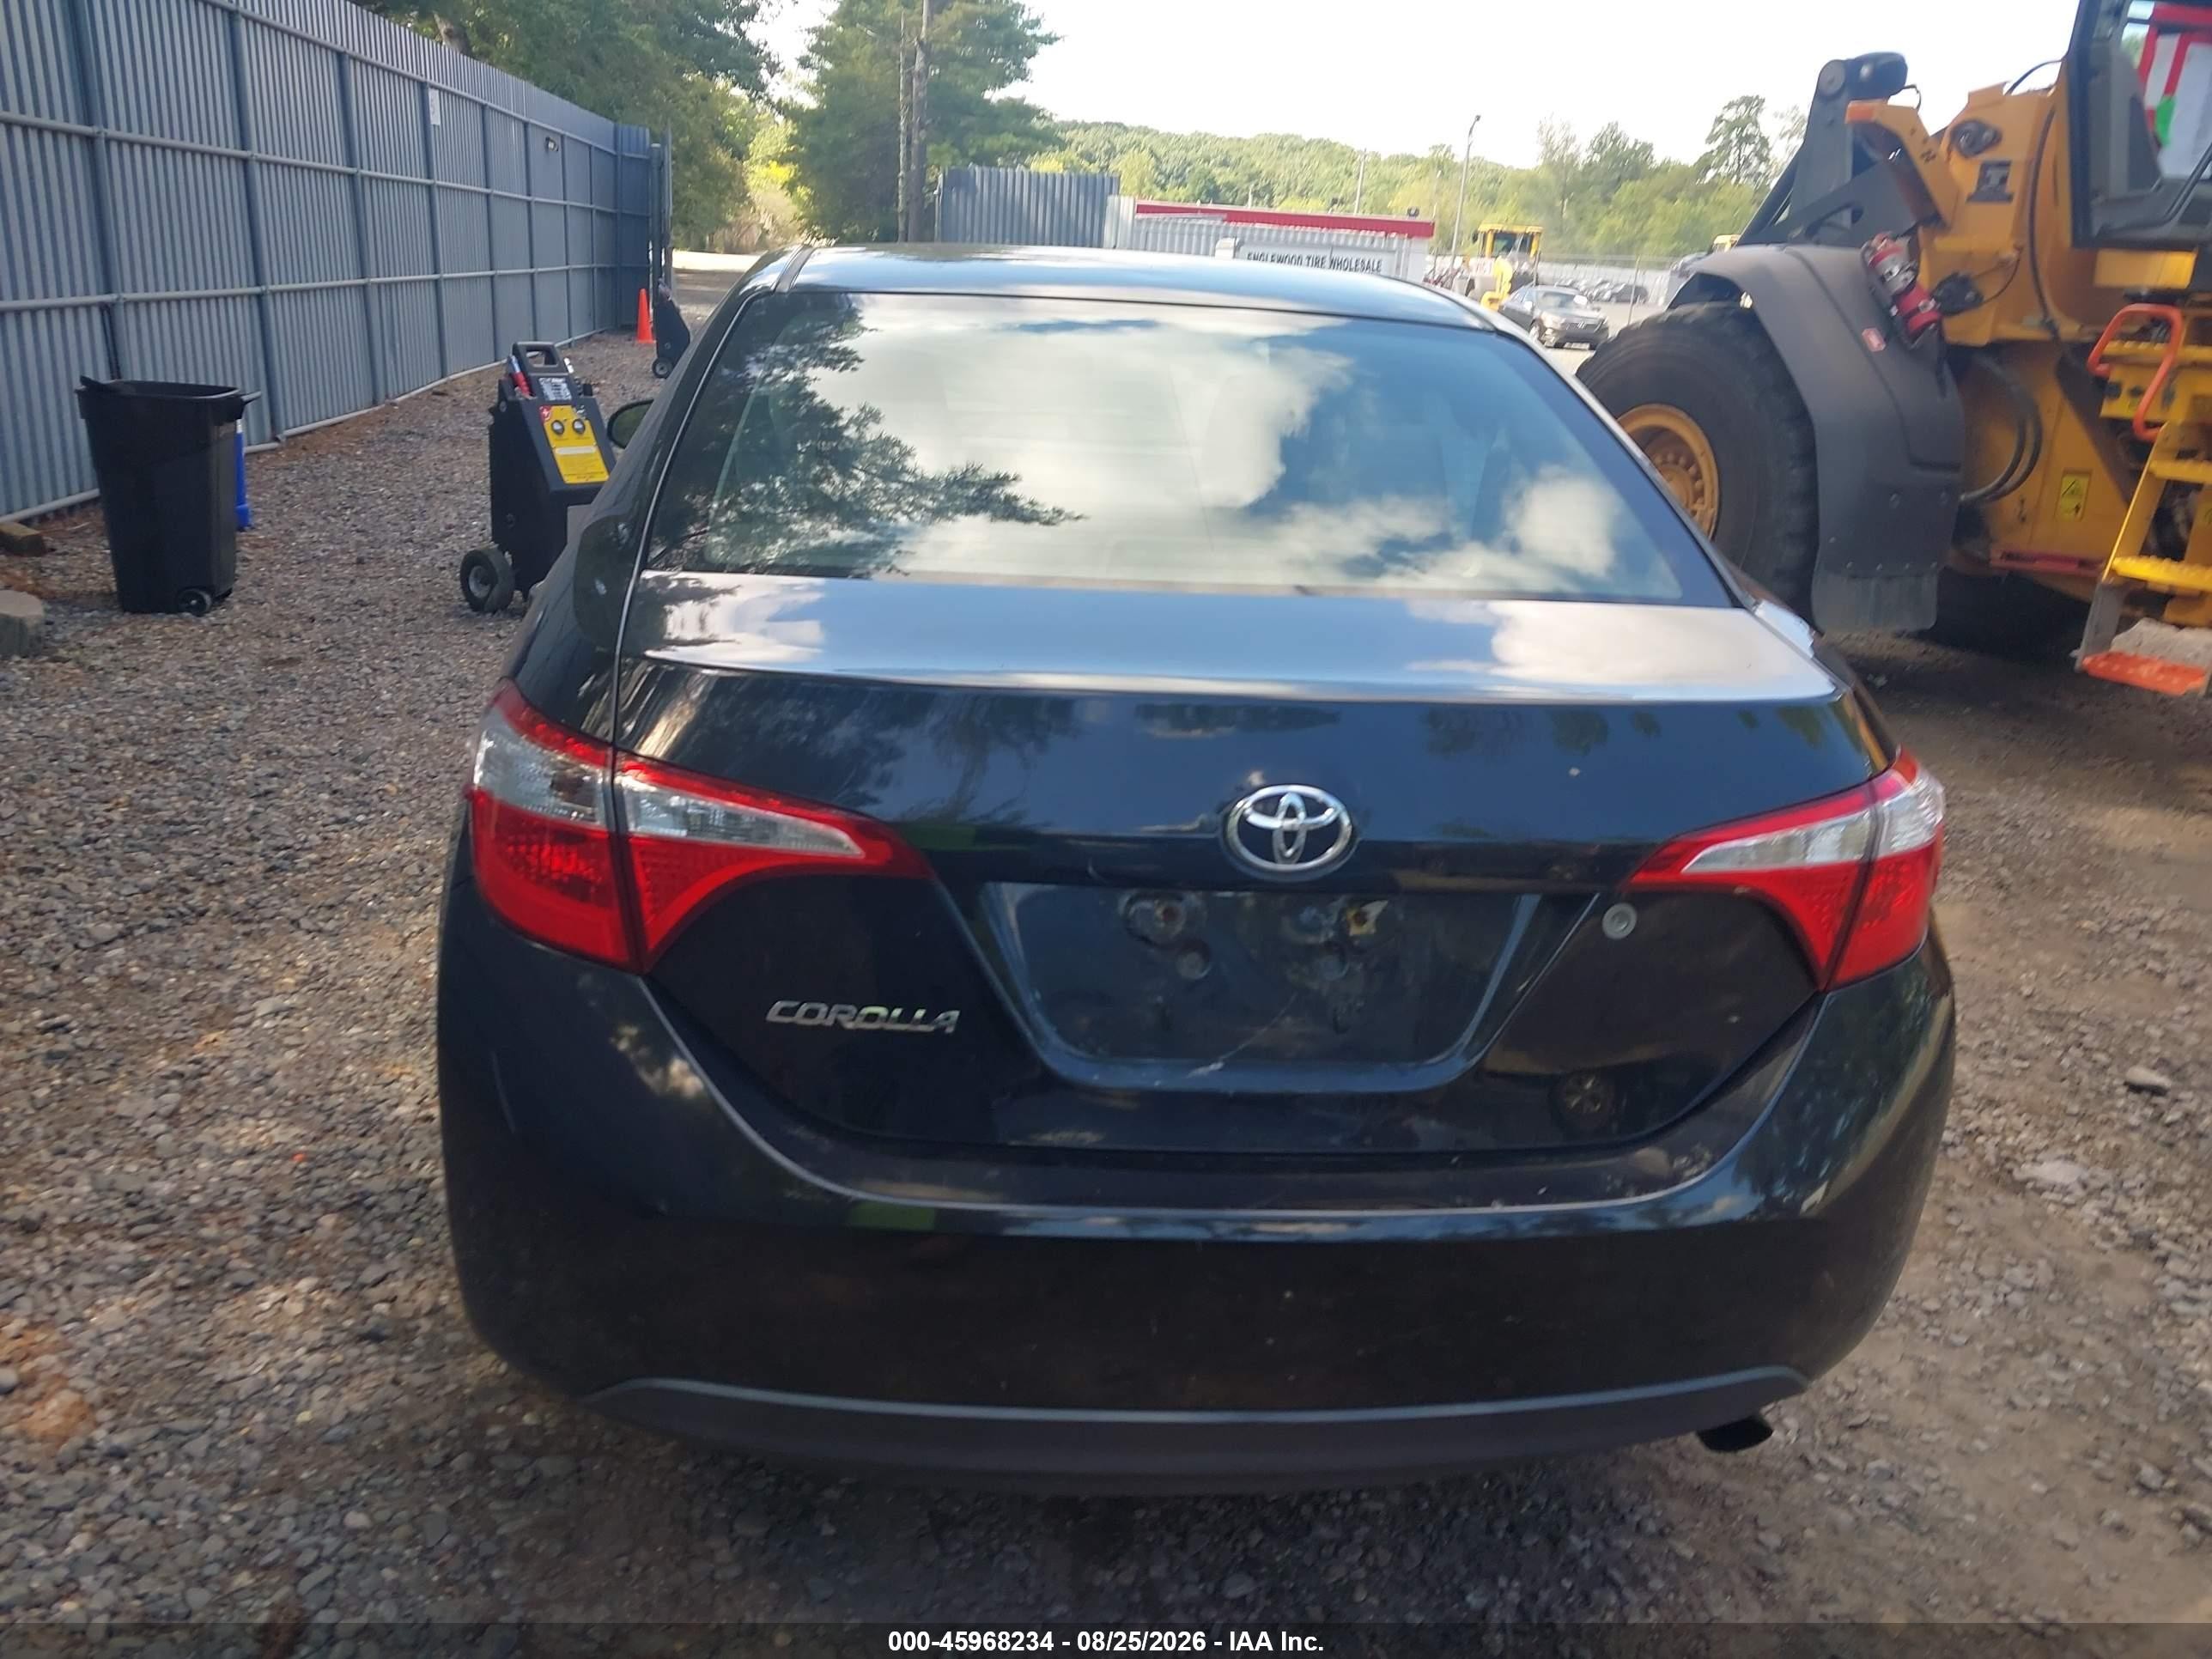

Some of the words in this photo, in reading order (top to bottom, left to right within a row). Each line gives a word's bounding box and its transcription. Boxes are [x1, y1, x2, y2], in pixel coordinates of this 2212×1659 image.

[1306, 254, 1327, 269] TIRE
[1328, 256, 1382, 273] WHOLESALE
[765, 1000, 961, 1034] COROLLA
